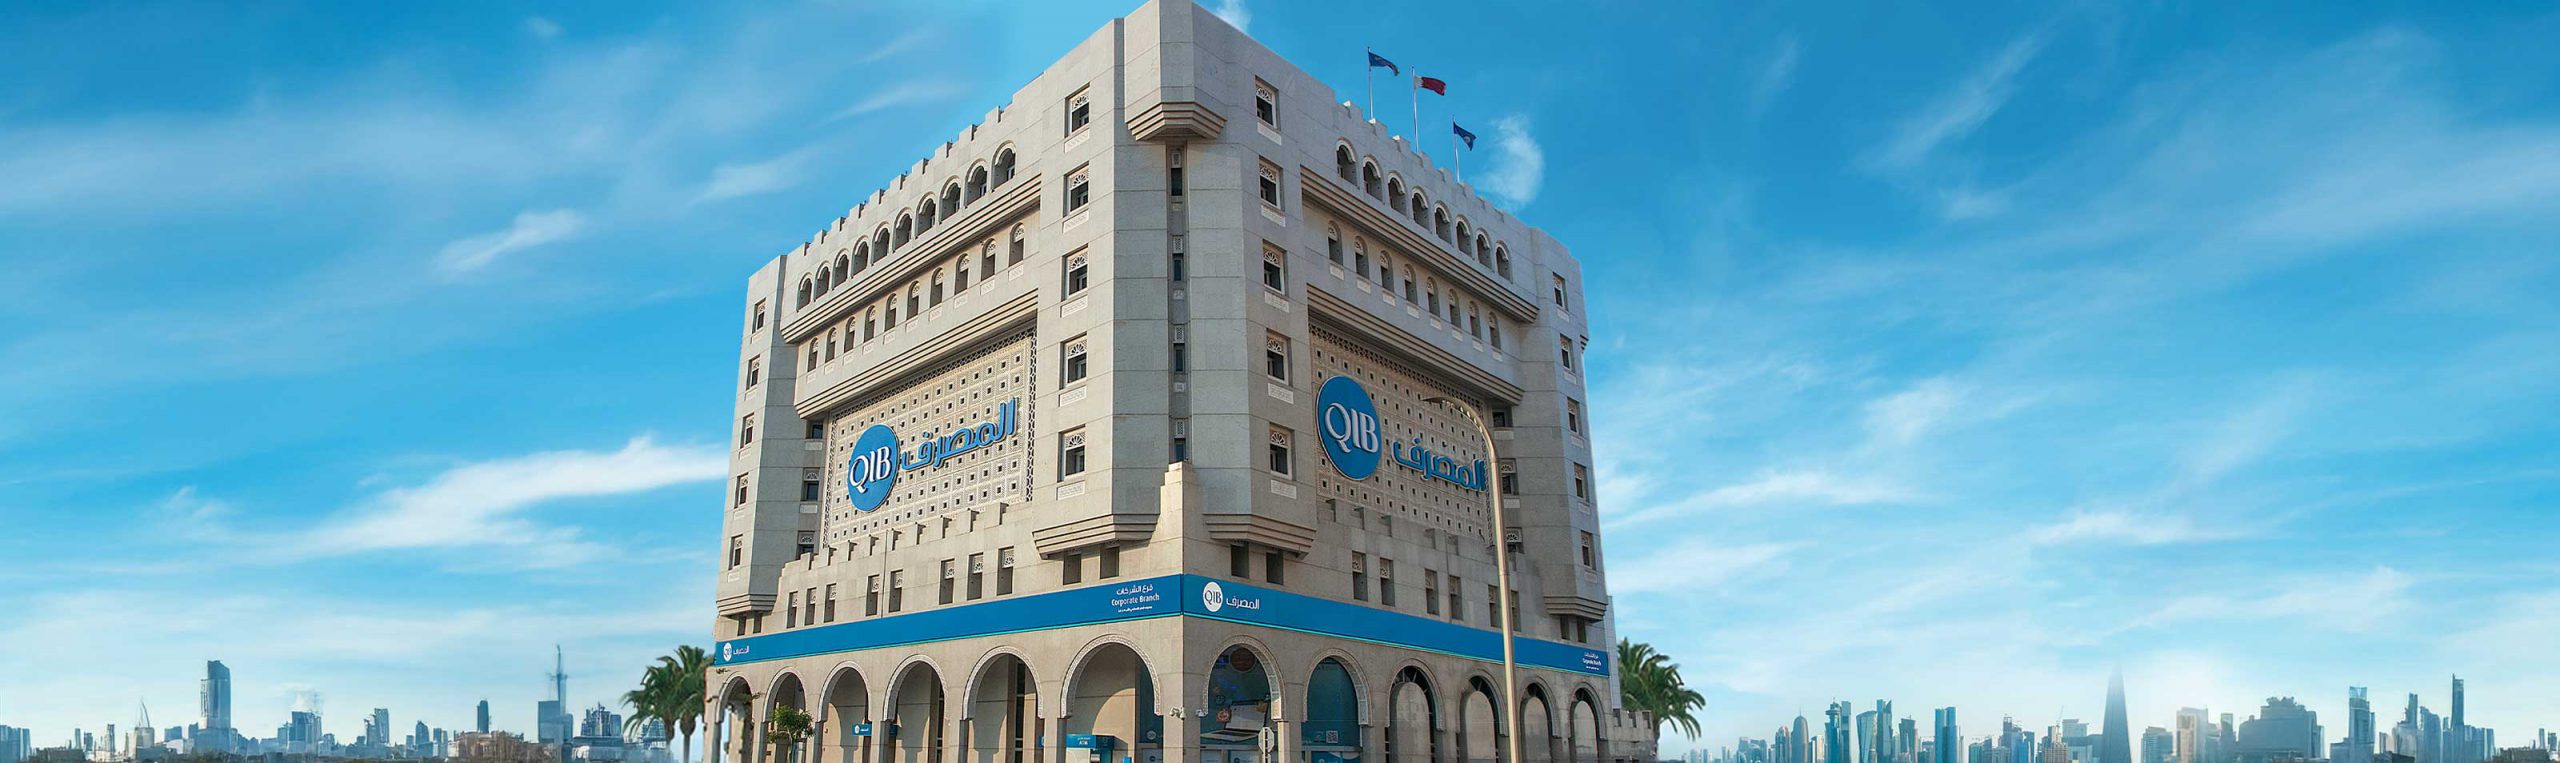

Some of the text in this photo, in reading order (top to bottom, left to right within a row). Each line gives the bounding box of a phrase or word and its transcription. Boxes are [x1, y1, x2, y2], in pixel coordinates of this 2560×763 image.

[900, 397, 1017, 471] المصرف
[1325, 402, 1379, 453] QIB
[850, 446, 893, 494] QIB
[1392, 438, 1487, 492] المصرف
[1111, 592, 1160, 607] Corporate Branch
[1204, 590, 1222, 605] QIB
[1225, 595, 1260, 610] المصرف
